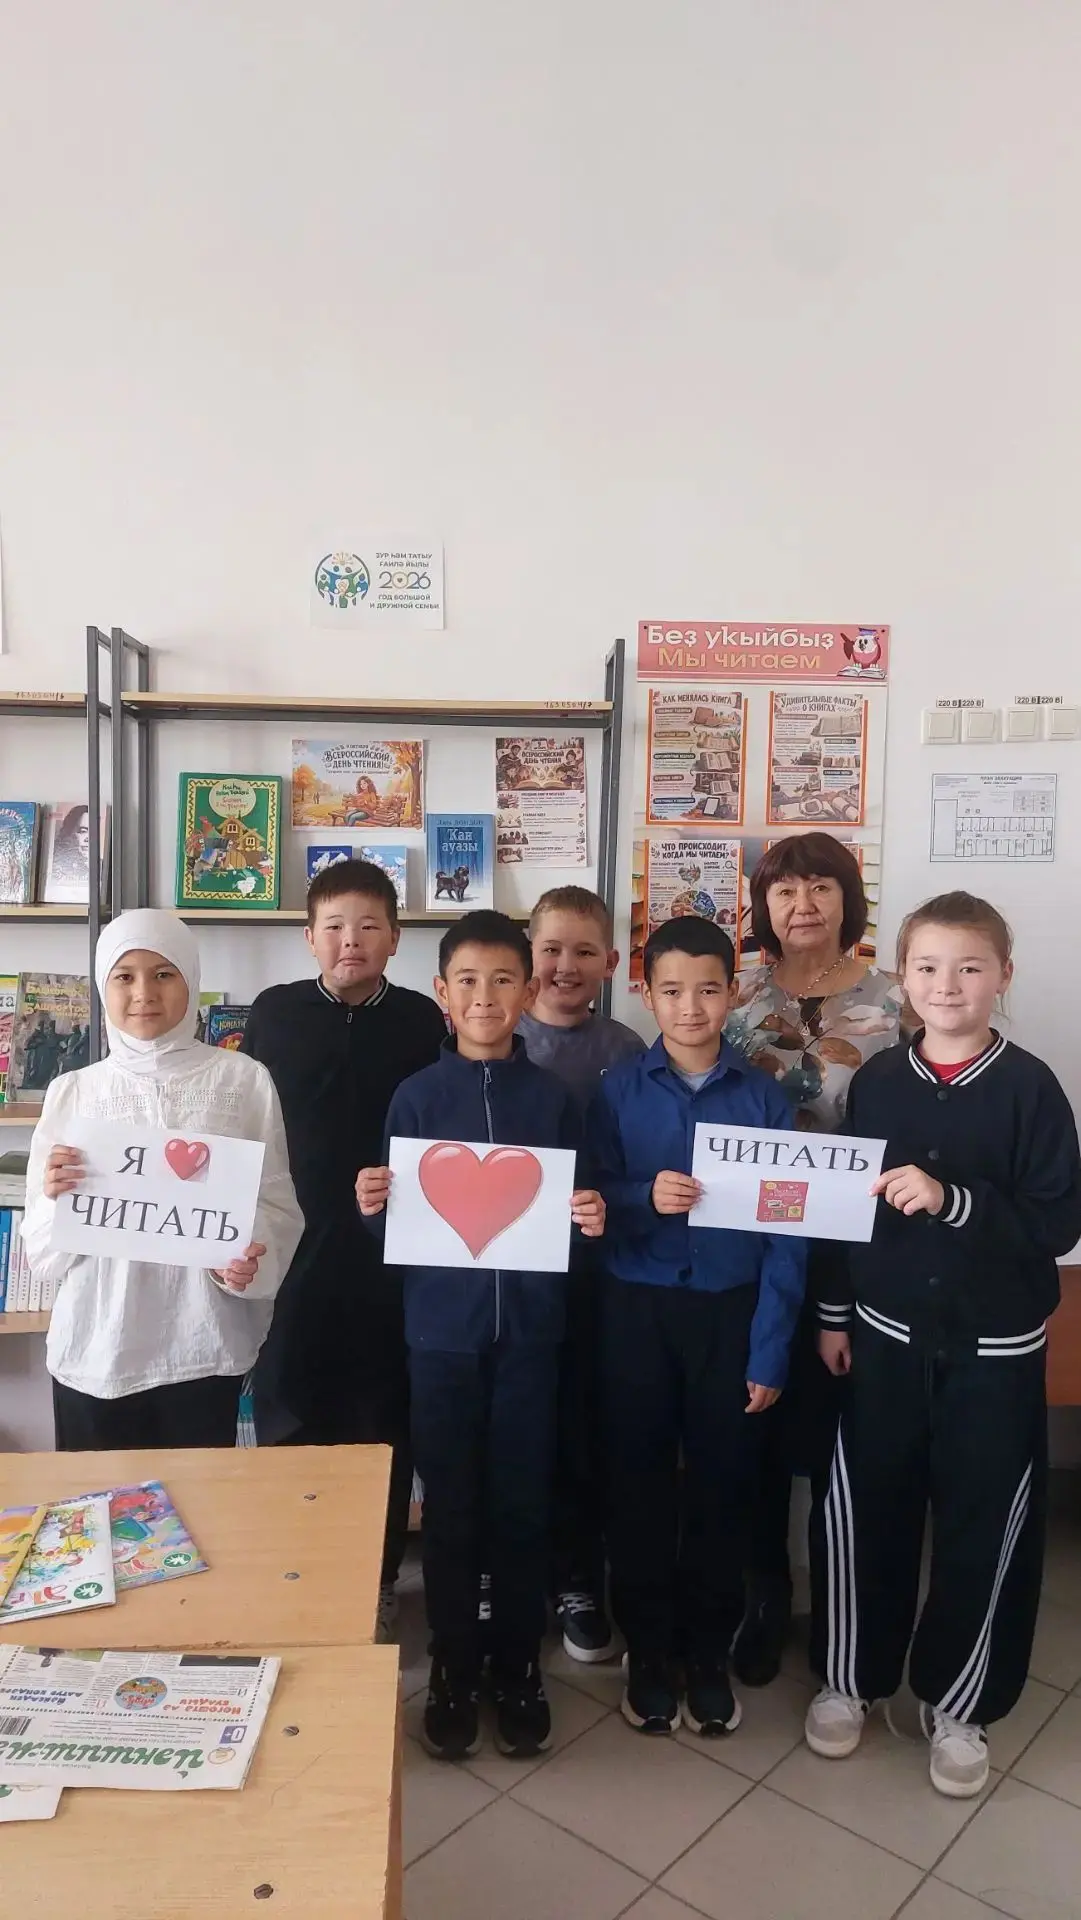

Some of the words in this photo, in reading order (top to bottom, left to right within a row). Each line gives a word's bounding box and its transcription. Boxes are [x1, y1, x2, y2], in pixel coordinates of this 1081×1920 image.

[378, 571, 431, 590] 2026
[648, 625, 697, 647] Беҙ
[658, 648, 706, 667] Мы
[715, 653, 821, 669] читаем
[663, 695, 676, 704] КАК
[677, 694, 709, 702] МЕНЯЛАСЬ
[712, 695, 732, 704] КНИГА
[833, 696, 857, 707] ФАКТЫ
[809, 704, 836, 712] КНИГАХ
[333, 760, 351, 769] ДЕНЬ
[354, 760, 383, 768] ЧТЕНИЯ!
[661, 843, 675, 851] ЧТО
[662, 851, 684, 859] КОГДА
[699, 851, 729, 859] ЧИТАЕМ?
[115, 1146, 149, 1176] Я
[706, 1136, 869, 1172] ЧИТАТЬ
[71, 1193, 239, 1242] ЧИТАТЬ
